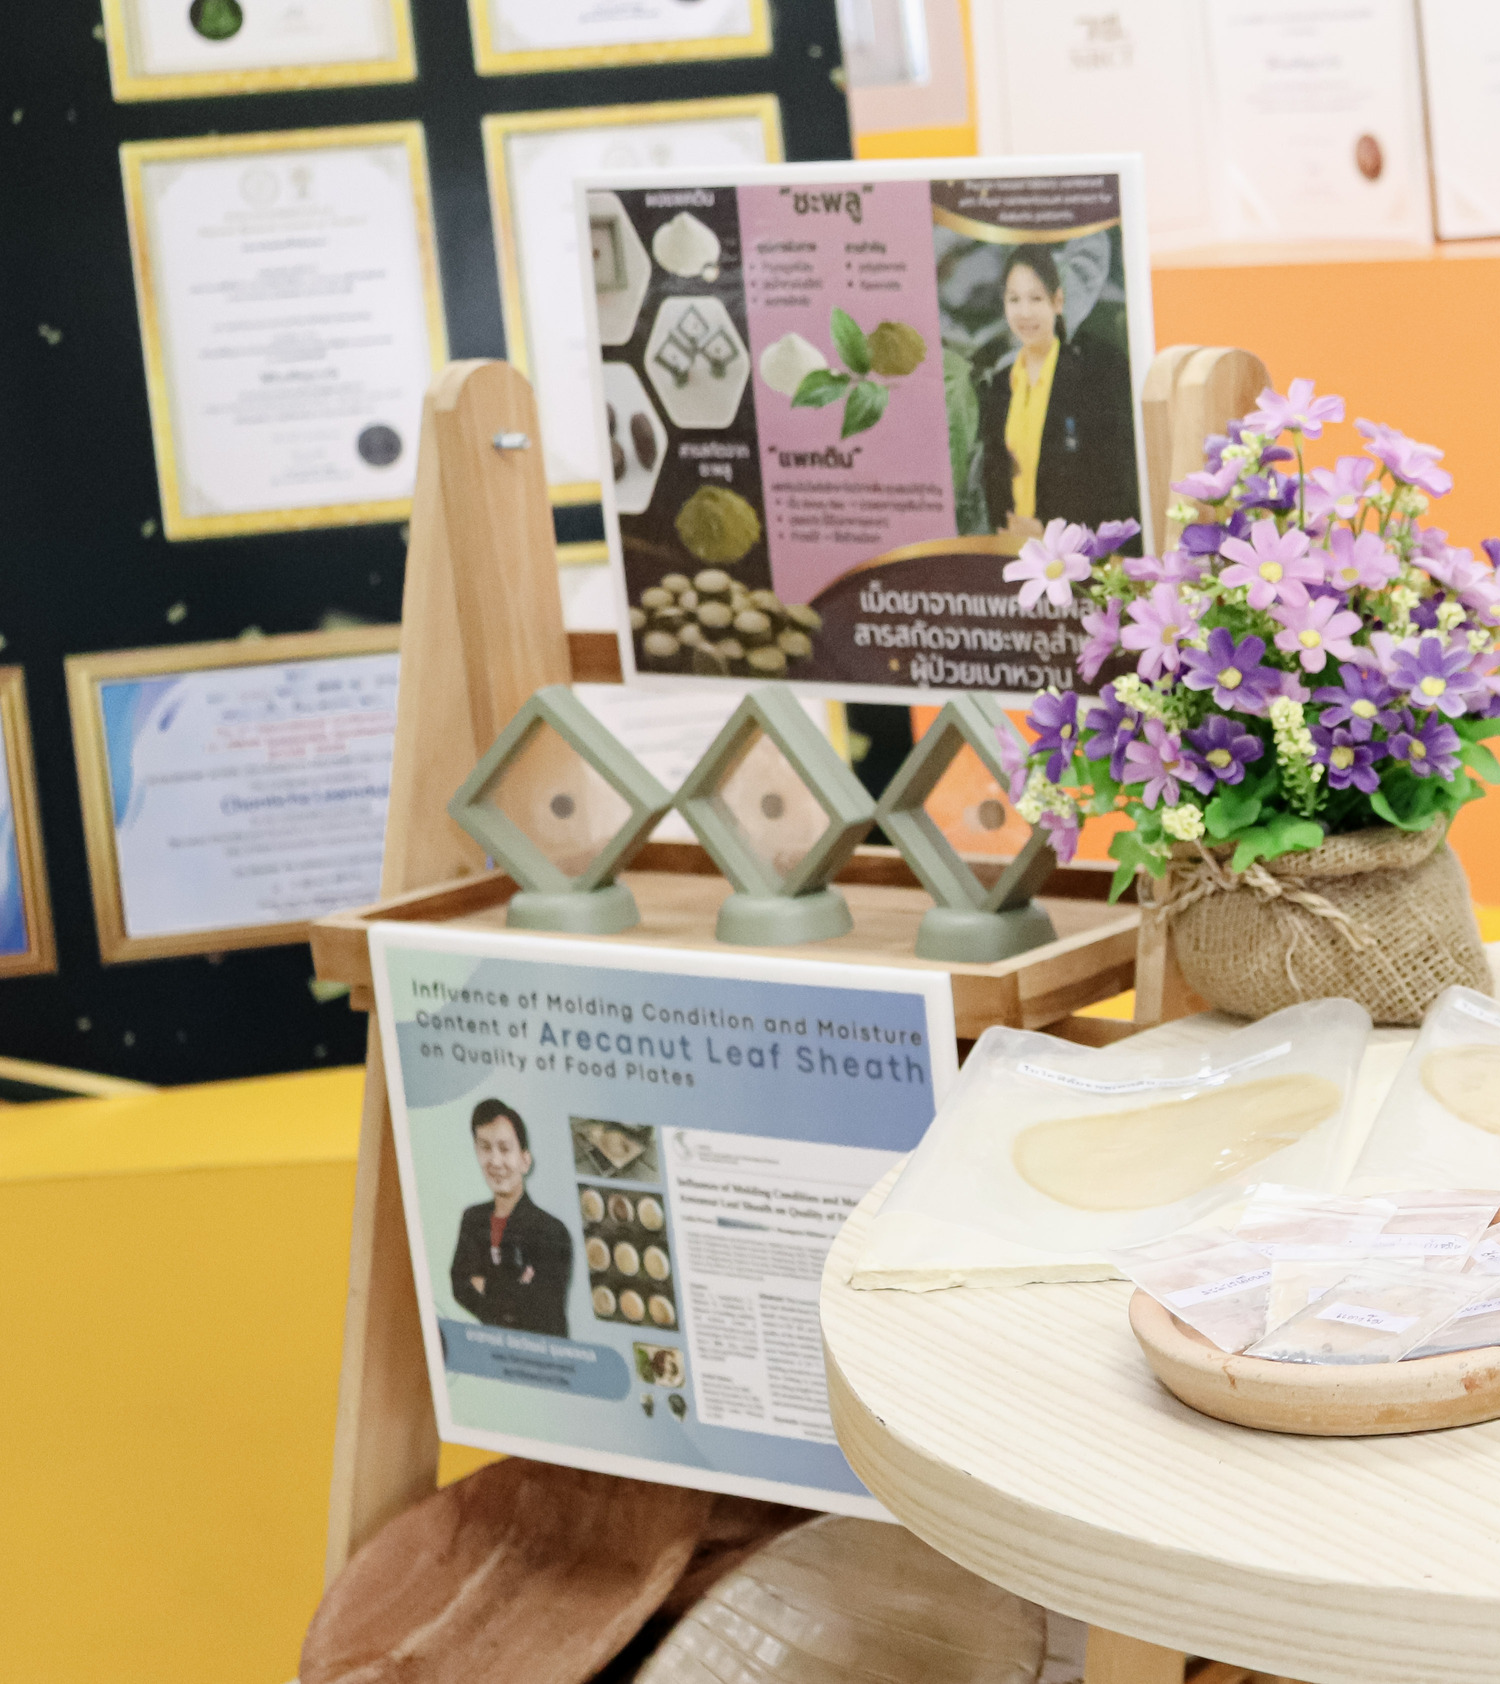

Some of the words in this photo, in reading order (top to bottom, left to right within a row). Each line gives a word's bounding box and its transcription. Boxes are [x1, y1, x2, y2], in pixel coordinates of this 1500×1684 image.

[909, 652, 1074, 691] ผู้ป่วยเบาหวาน
[412, 978, 509, 1008] Influence
[518, 992, 538, 1009] of
[547, 994, 633, 1023] Molding
[641, 1002, 755, 1031] Condition
[764, 1017, 808, 1037] and
[816, 1018, 922, 1046] Moisture
[416, 1010, 500, 1036] Content
[508, 1021, 528, 1039] of
[539, 1021, 692, 1062] Arecanut
[706, 1035, 782, 1070] Leaf
[798, 1046, 925, 1085] Sheath
[420, 1042, 444, 1058] on
[452, 1043, 528, 1073] Quality
[535, 1055, 556, 1071] of
[564, 1056, 617, 1079] Food
[625, 1062, 695, 1088] Plates
